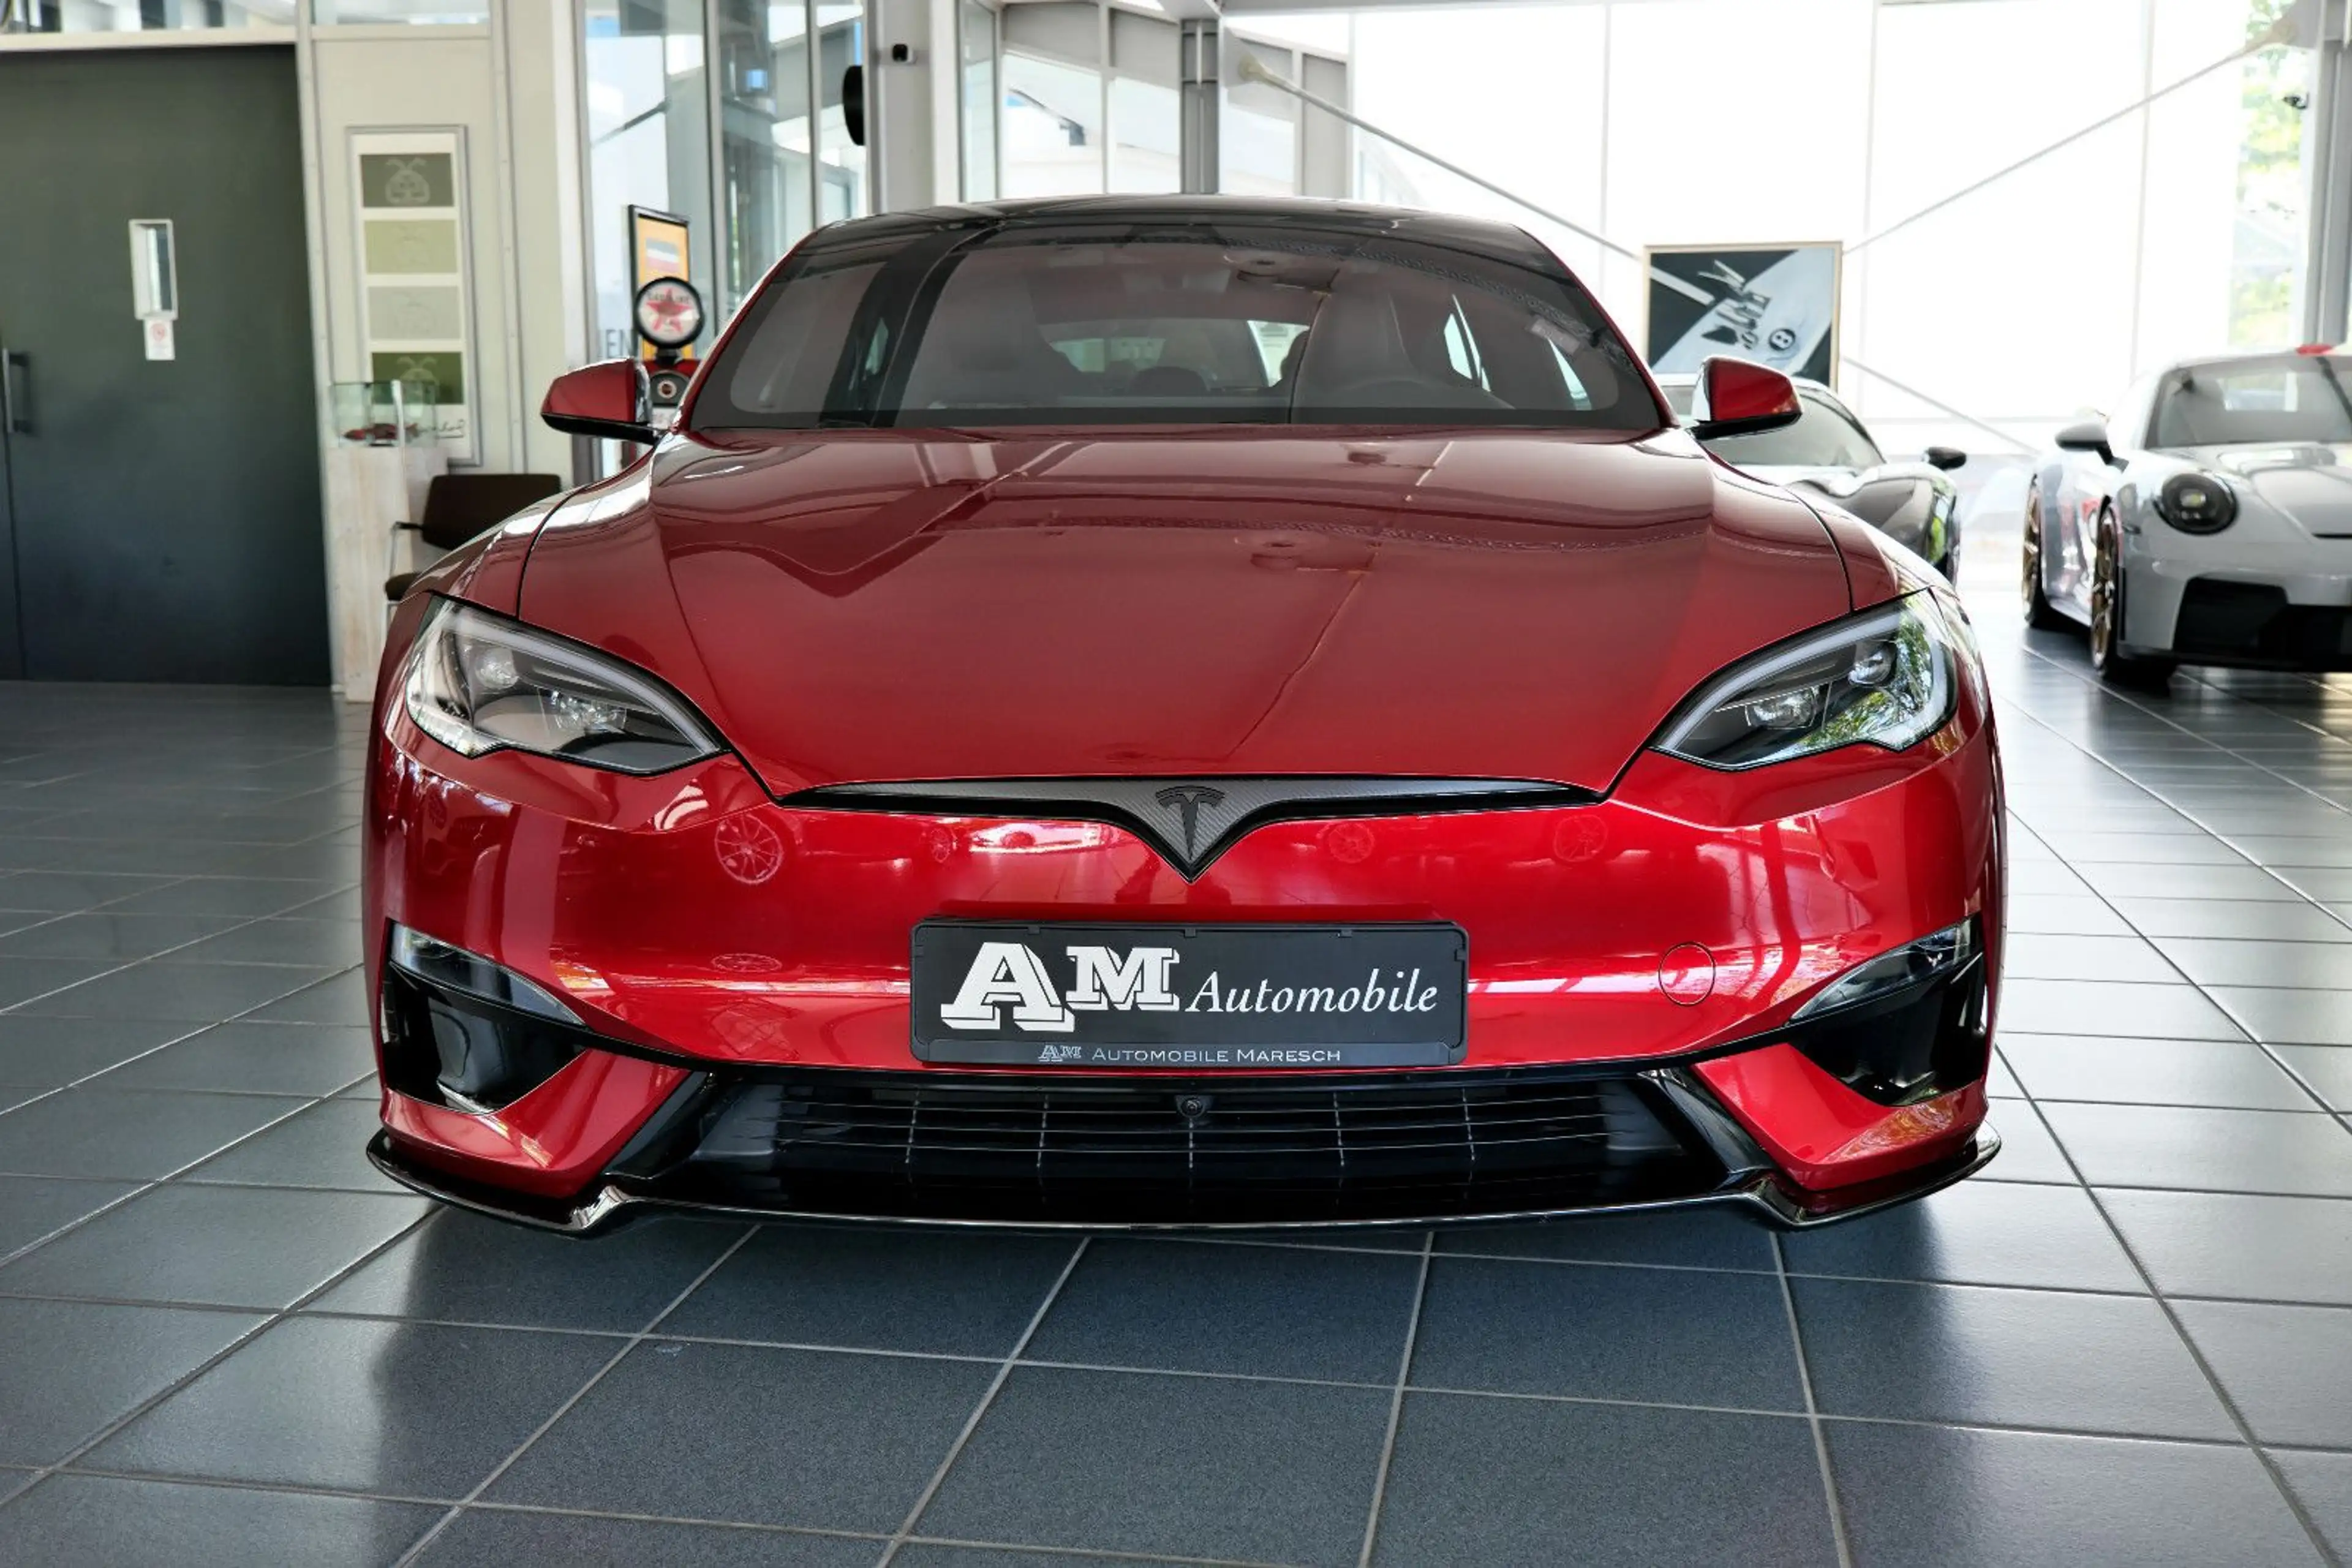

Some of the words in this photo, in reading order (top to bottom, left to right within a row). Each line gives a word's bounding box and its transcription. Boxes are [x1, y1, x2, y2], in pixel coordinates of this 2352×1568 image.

[941, 942, 1180, 1032] AM
[1185, 968, 1438, 1012] Automobile
[1038, 1044, 1081, 1061] AM
[1091, 1047, 1229, 1062] AUTOMOBILE
[1237, 1049, 1340, 1062] MARESCH
